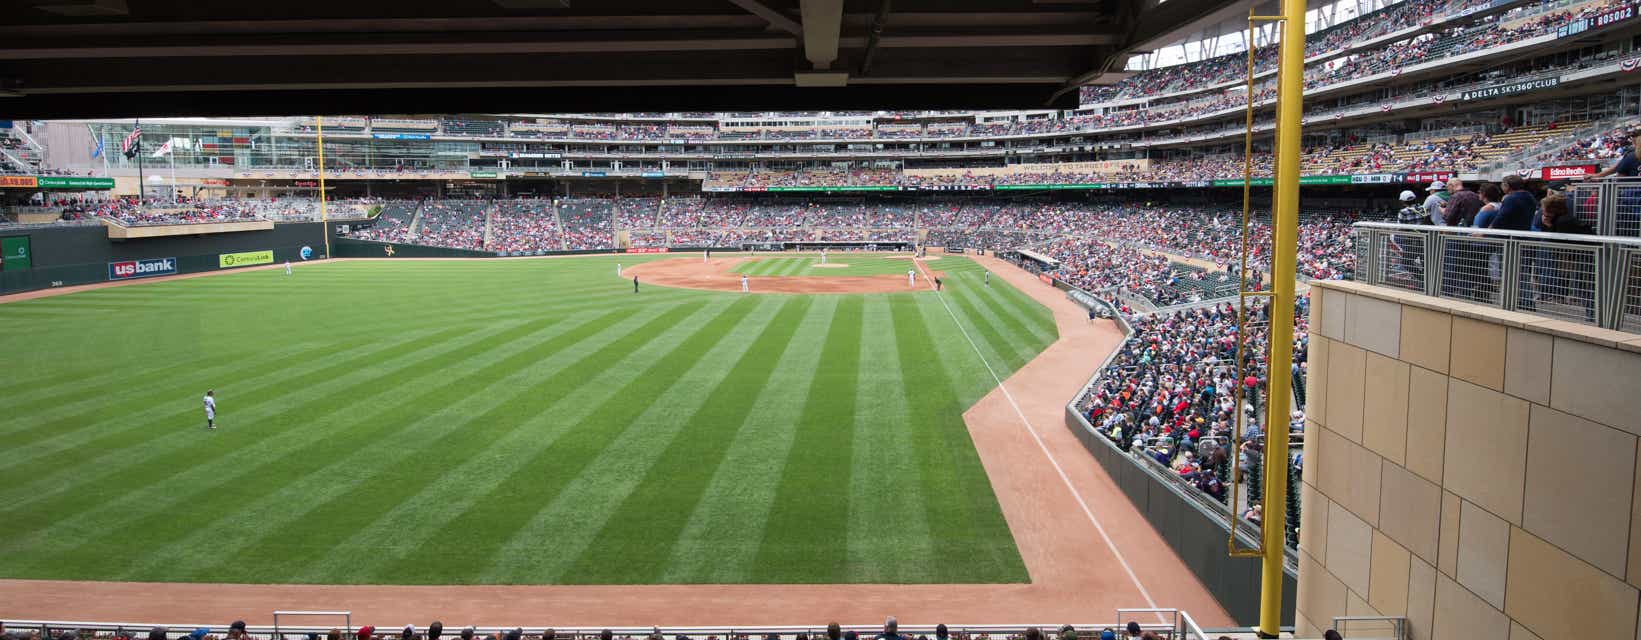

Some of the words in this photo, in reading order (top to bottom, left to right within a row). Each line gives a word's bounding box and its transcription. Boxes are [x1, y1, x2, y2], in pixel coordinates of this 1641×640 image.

[1471, 88, 1499, 99] DELTA
[1550, 168, 1566, 176] Edina
[1566, 167, 1586, 175] Realty
